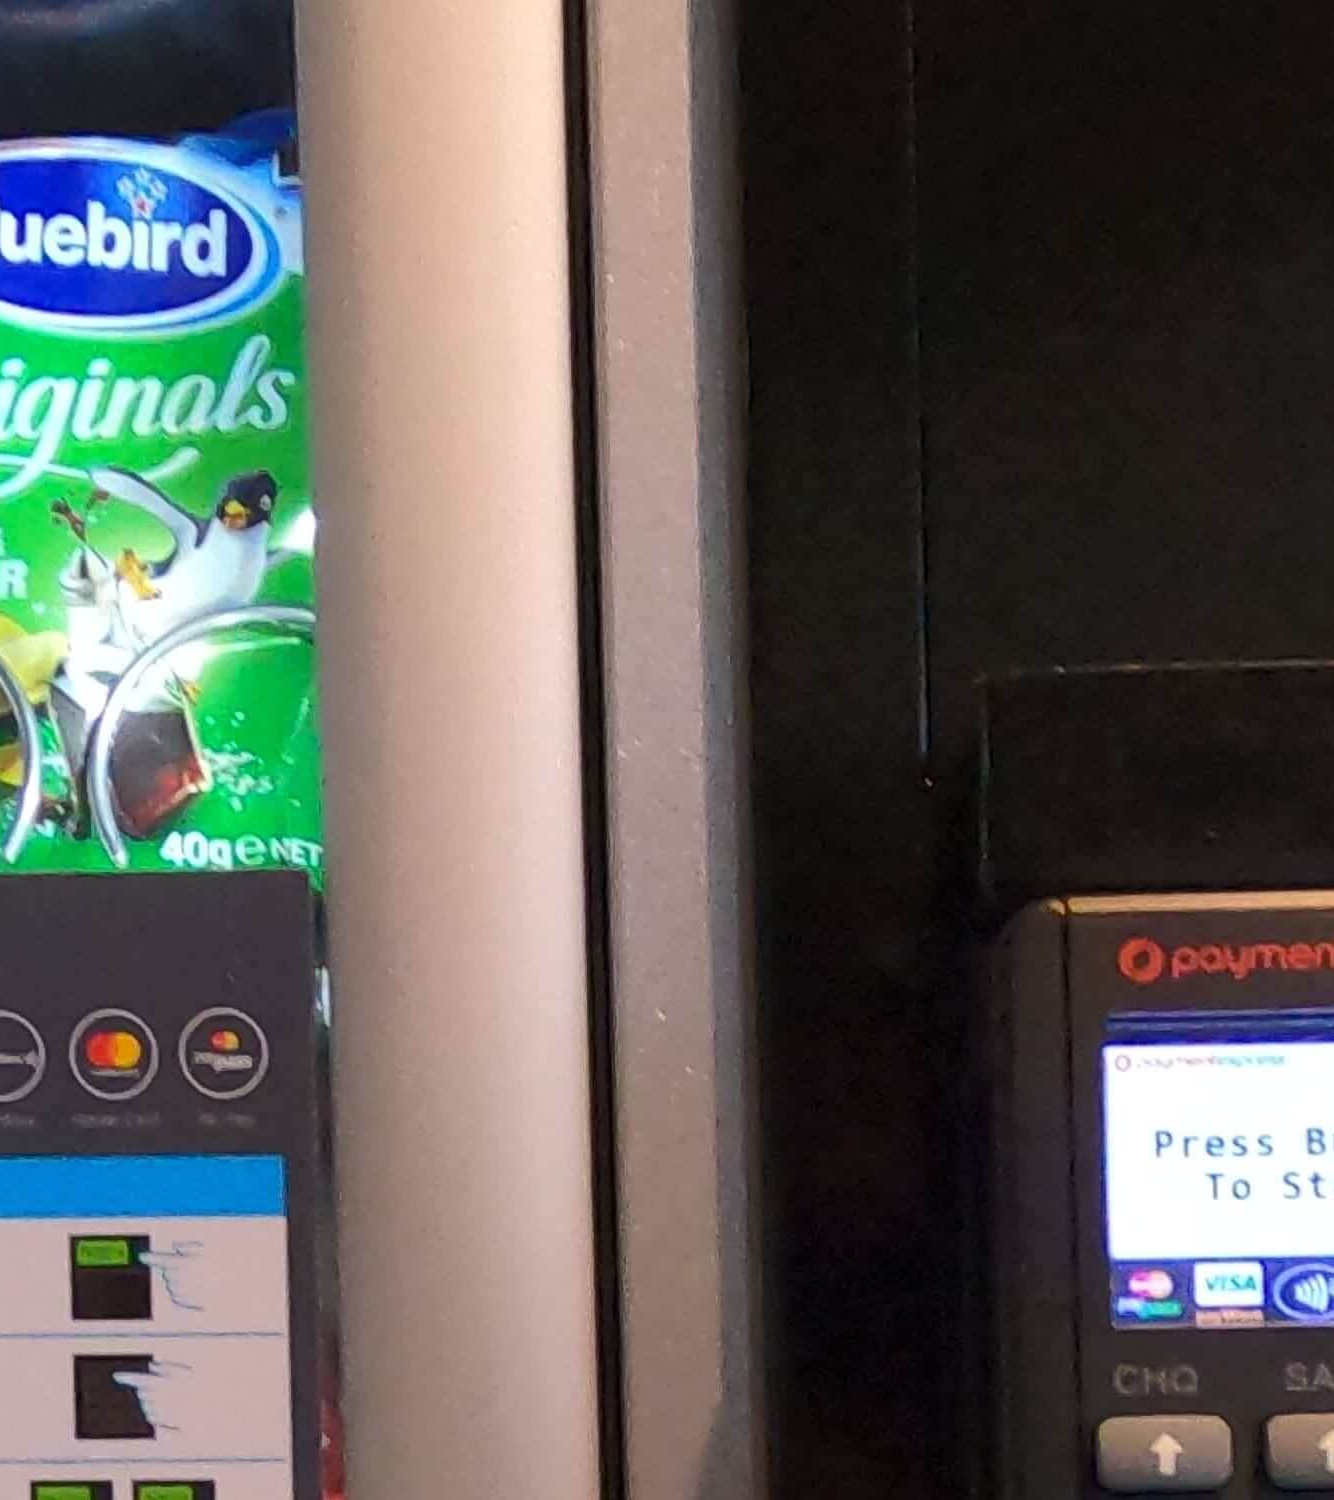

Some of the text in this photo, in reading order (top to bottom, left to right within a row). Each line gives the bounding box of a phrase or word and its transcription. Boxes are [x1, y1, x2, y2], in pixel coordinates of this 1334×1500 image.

[1155, 1130, 1275, 1158] Press
[1205, 1172, 1252, 1201] To
[1205, 1274, 1259, 1292] VISA
[1111, 1363, 1199, 1396] CHQ
